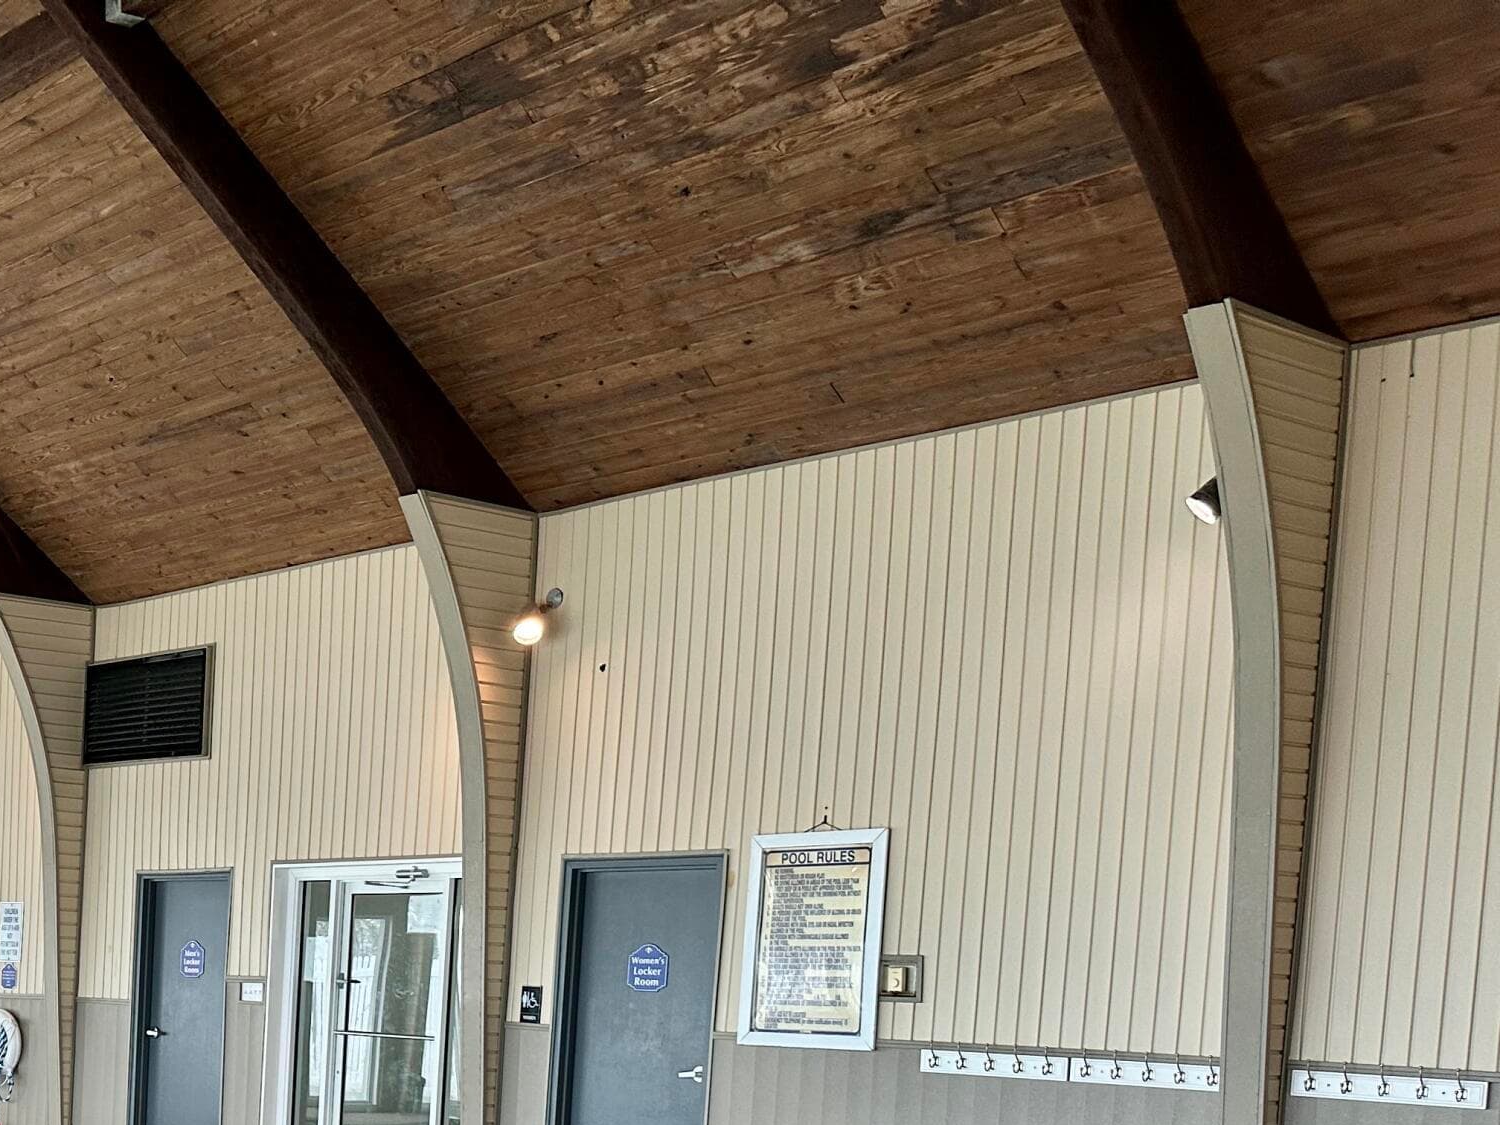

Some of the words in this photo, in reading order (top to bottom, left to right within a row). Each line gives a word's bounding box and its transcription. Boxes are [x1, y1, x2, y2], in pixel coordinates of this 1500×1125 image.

[781, 852, 814, 864] POOL
[816, 850, 856, 863] RULES
[184, 949, 200, 957] Men's
[631, 956, 665, 965] Women's
[633, 966, 662, 976] Locker
[634, 977, 659, 986] Room
